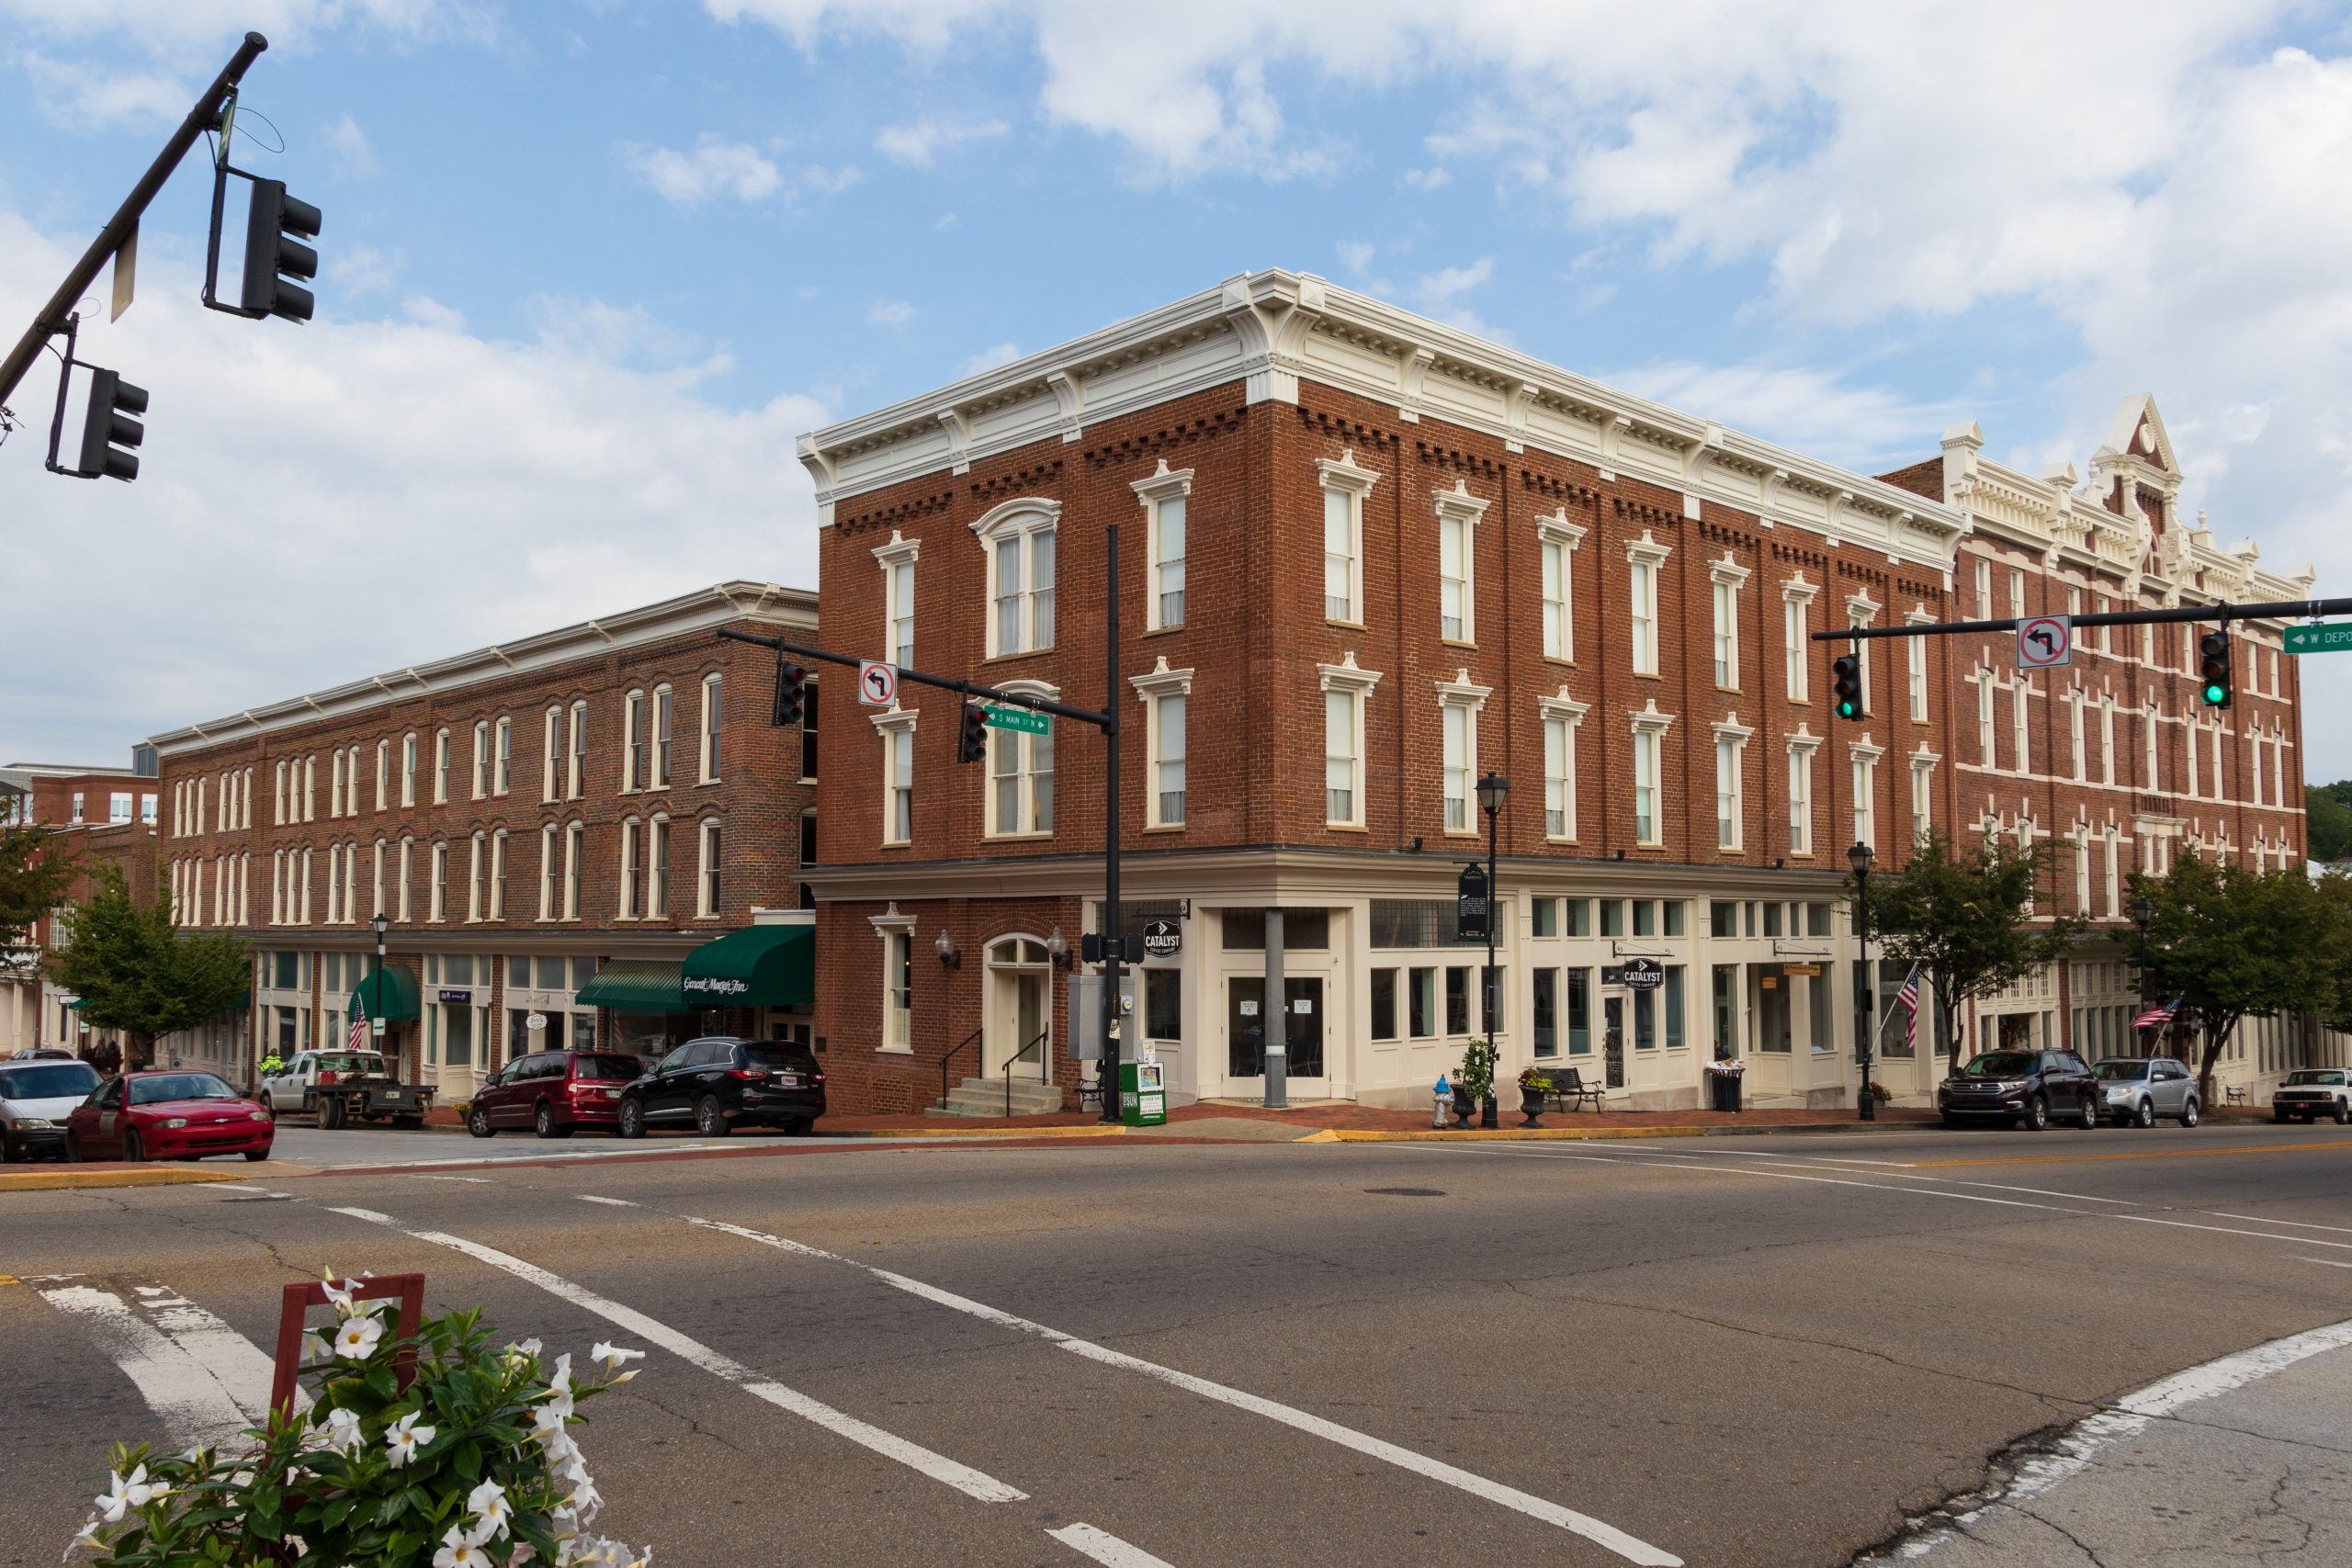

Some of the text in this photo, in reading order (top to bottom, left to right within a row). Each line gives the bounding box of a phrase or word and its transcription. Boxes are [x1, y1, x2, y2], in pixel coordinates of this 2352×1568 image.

[2310, 631, 2352, 644] W DEPO
[998, 714, 1003, 722] S
[1006, 716, 1020, 725] MAIN
[1145, 935, 1180, 947] CATALYST
[1624, 971, 1661, 982] CATALYST
[728, 979, 749, 995] Inn
[1126, 1095, 1137, 1108] SUN
